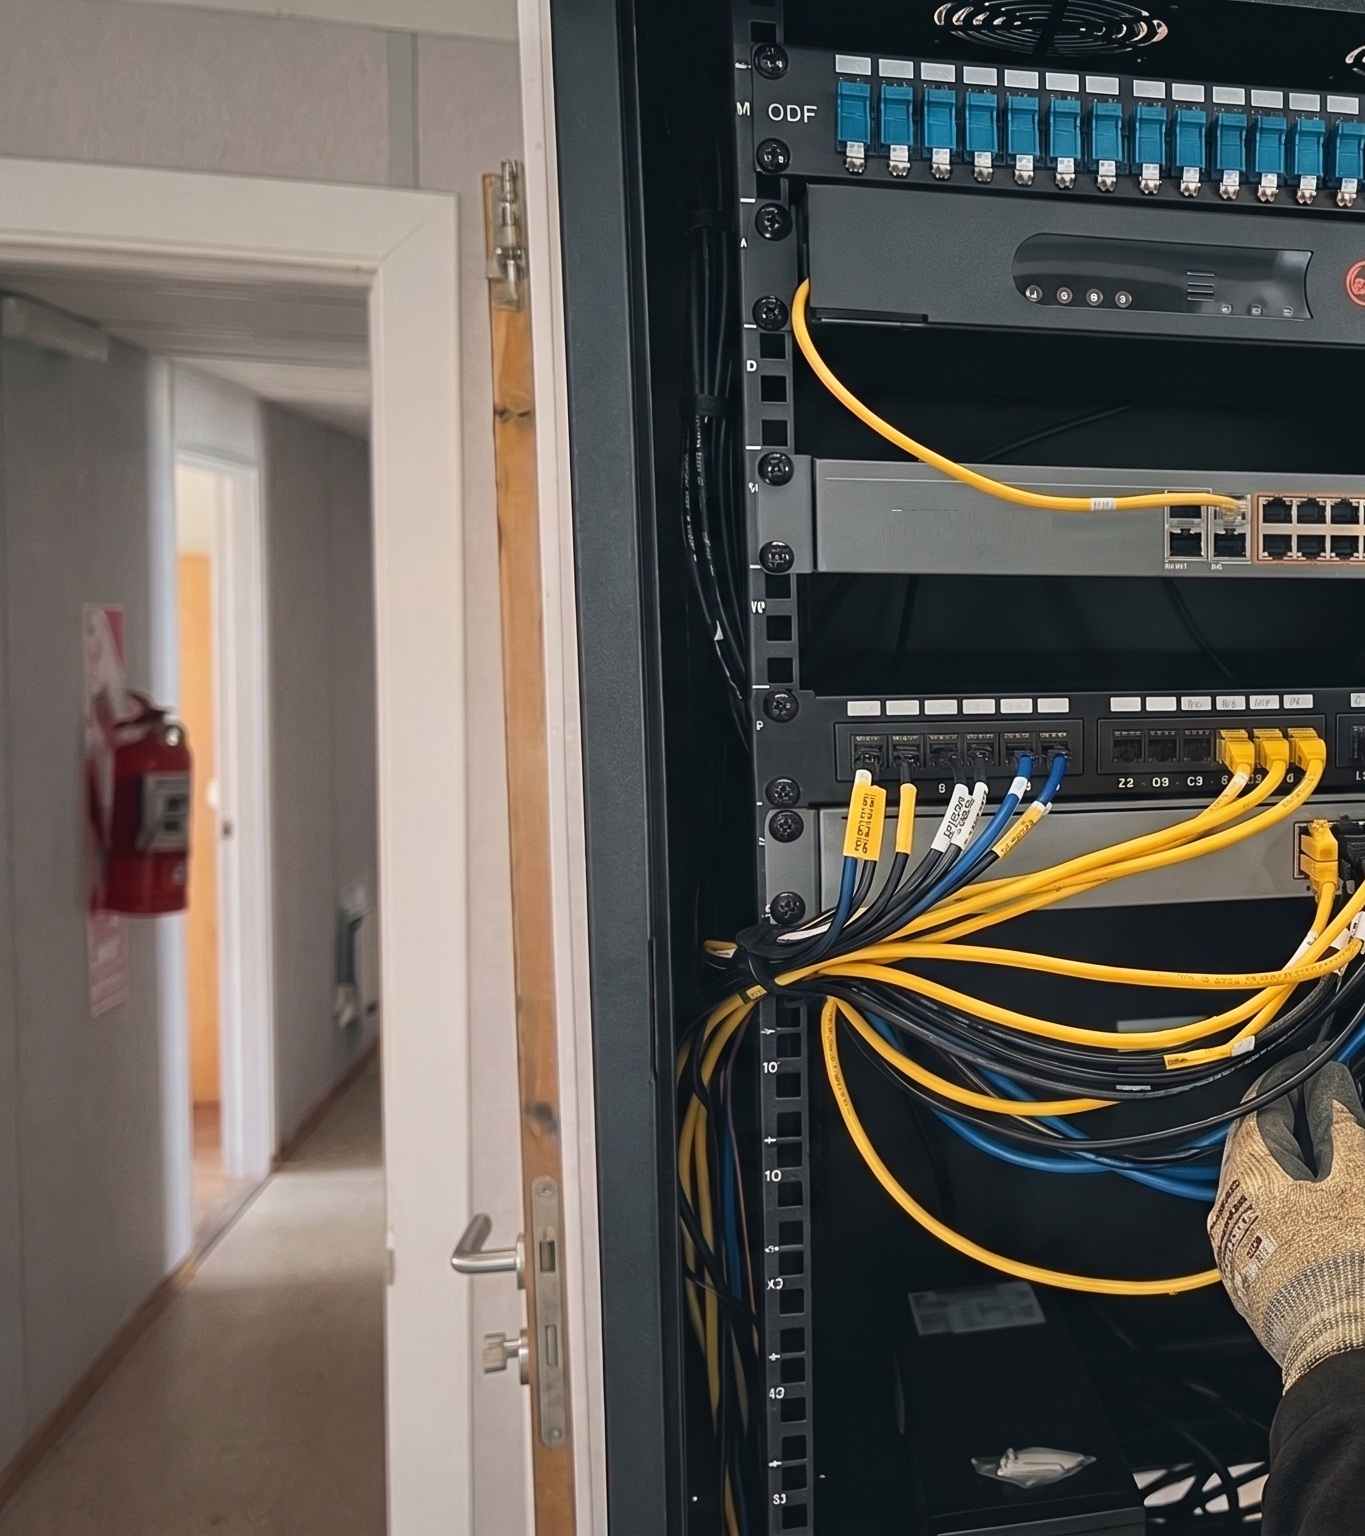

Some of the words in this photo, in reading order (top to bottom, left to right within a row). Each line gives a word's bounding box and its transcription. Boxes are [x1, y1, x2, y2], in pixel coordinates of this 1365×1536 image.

[767, 103, 818, 123] ODF
[746, 359, 757, 372] D
[762, 1061, 778, 1074] 10
[764, 1169, 782, 1182] 10
